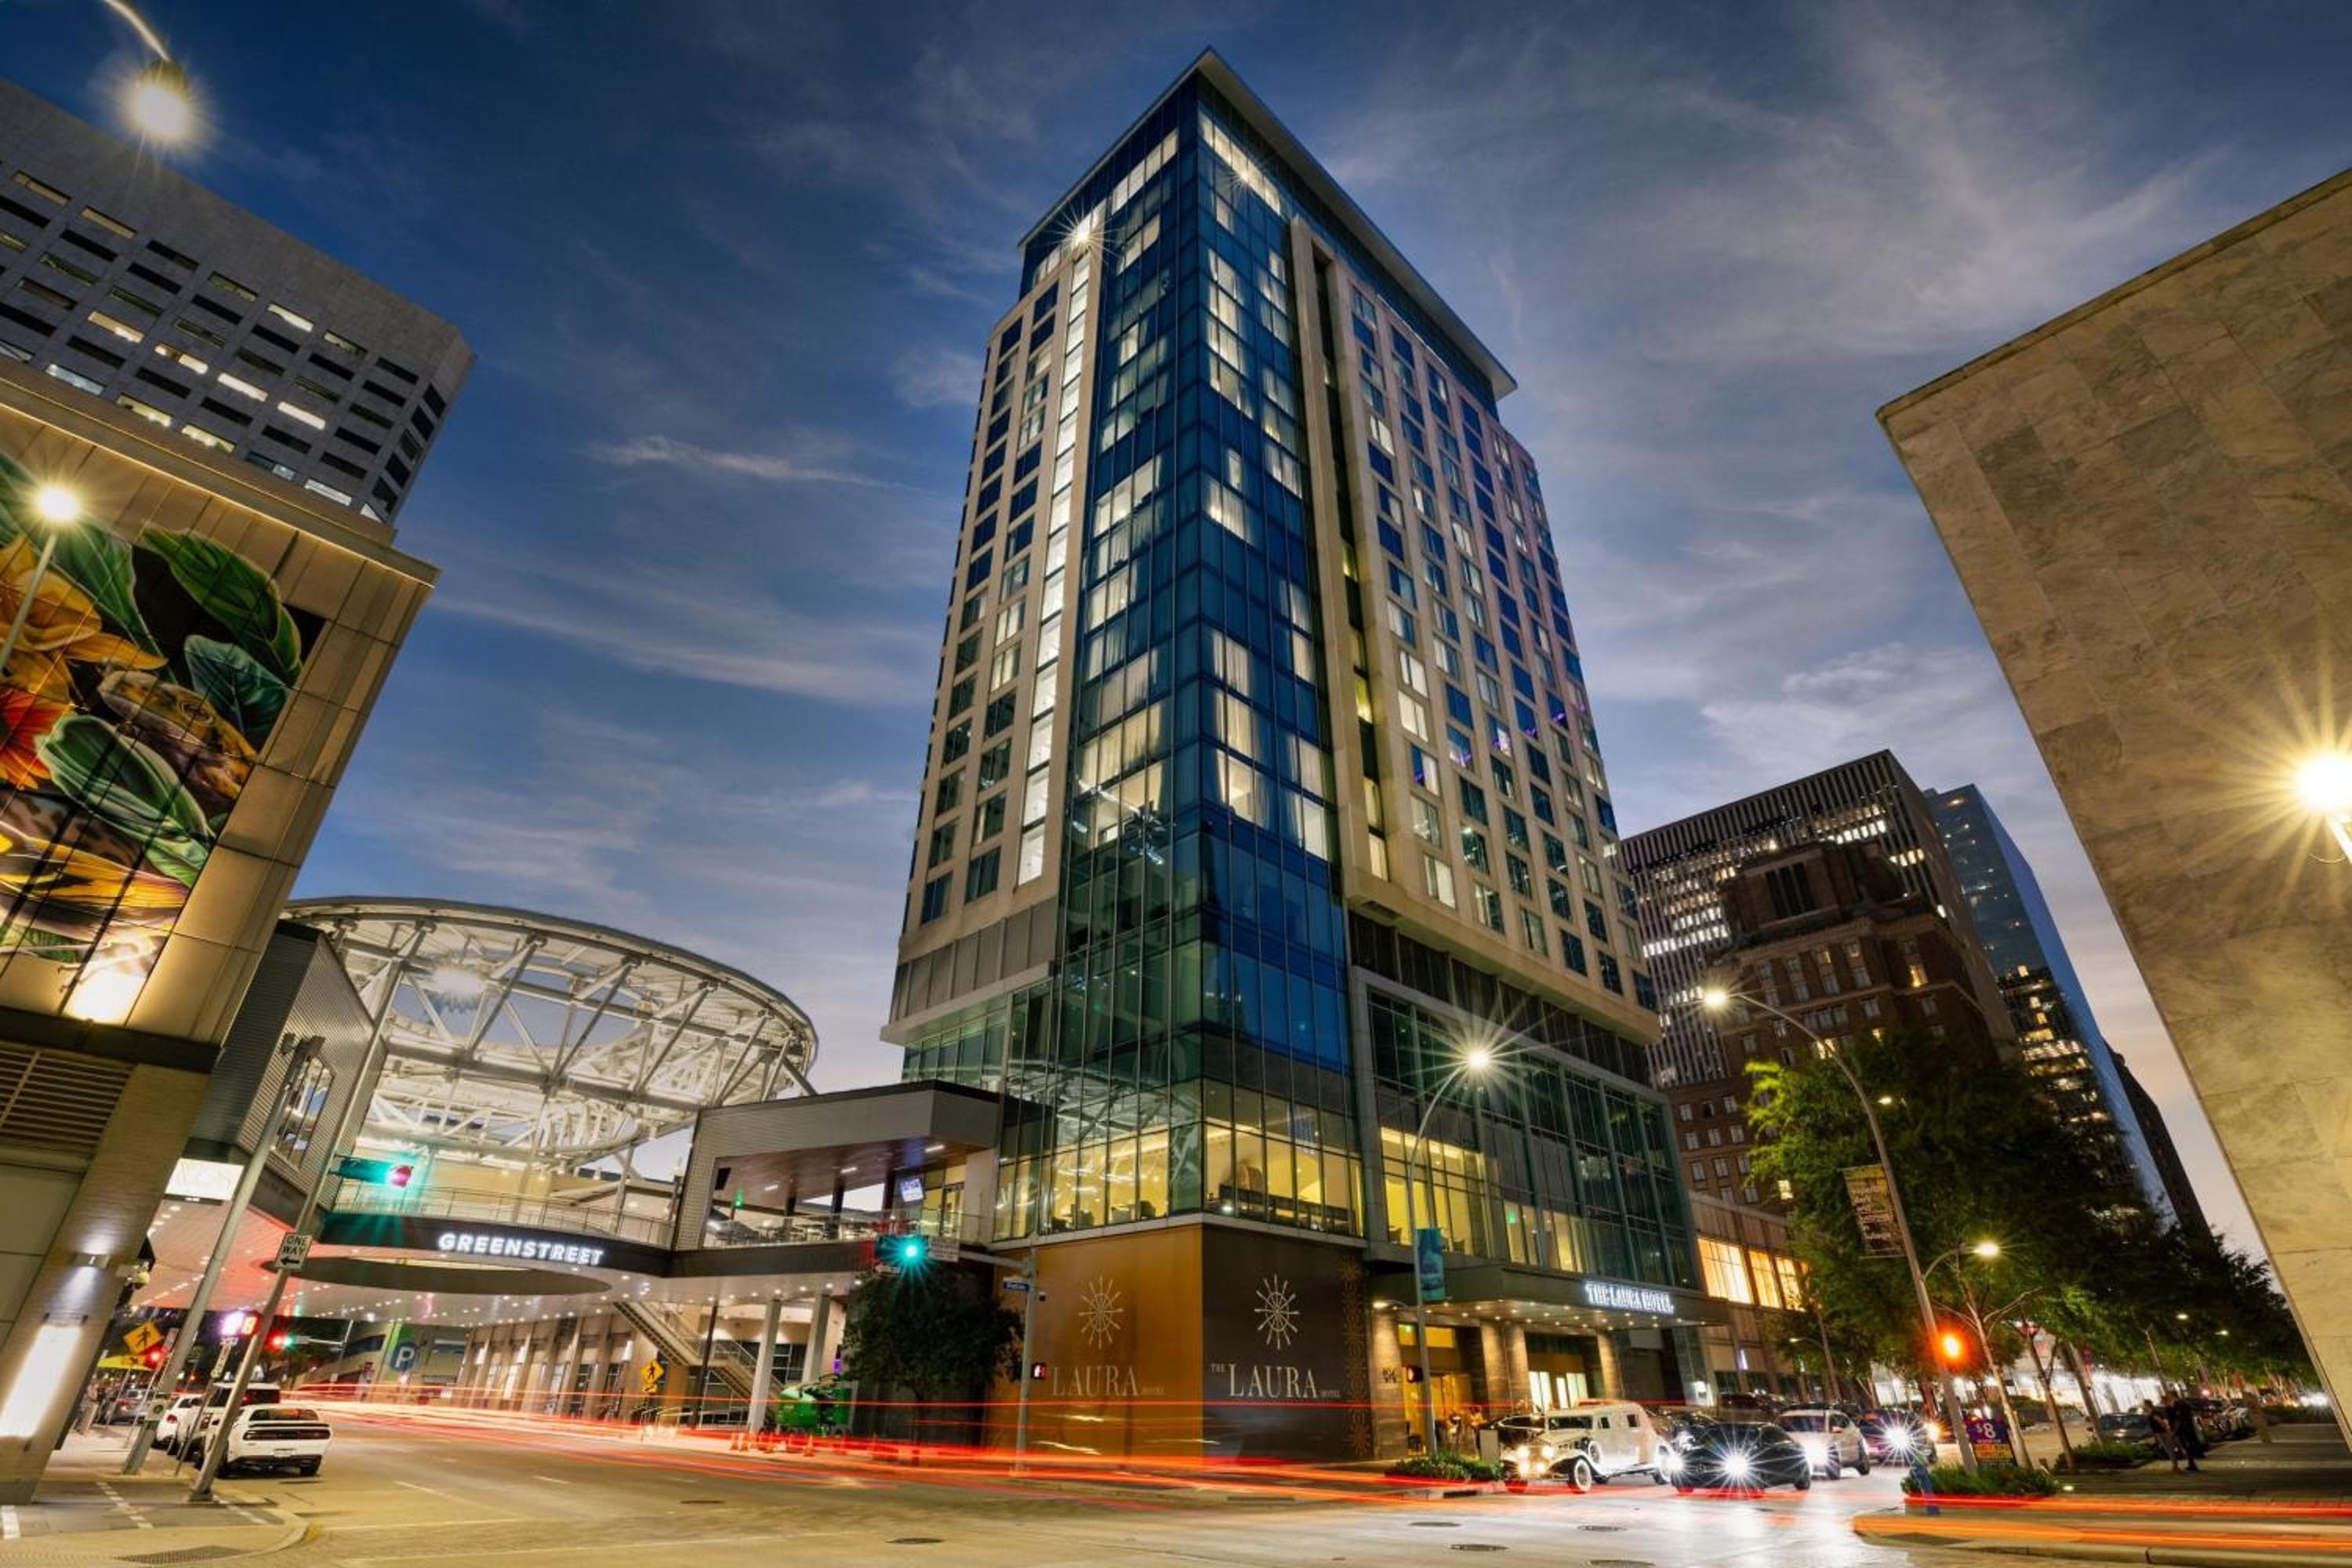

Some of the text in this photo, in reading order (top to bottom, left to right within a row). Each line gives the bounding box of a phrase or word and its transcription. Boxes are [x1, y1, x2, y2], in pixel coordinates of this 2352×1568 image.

[283, 1245, 304, 1255] WAY
[286, 1236, 305, 1245] ONE
[438, 1232, 603, 1265] GREENSTREET
[1584, 1282, 1675, 1314] THE LAURA HOTEL
[394, 1346, 415, 1368] P
[1053, 1365, 1138, 1396] LAURA
[1229, 1363, 1318, 1398] LAURA
[1976, 1422, 1995, 1439] $8
